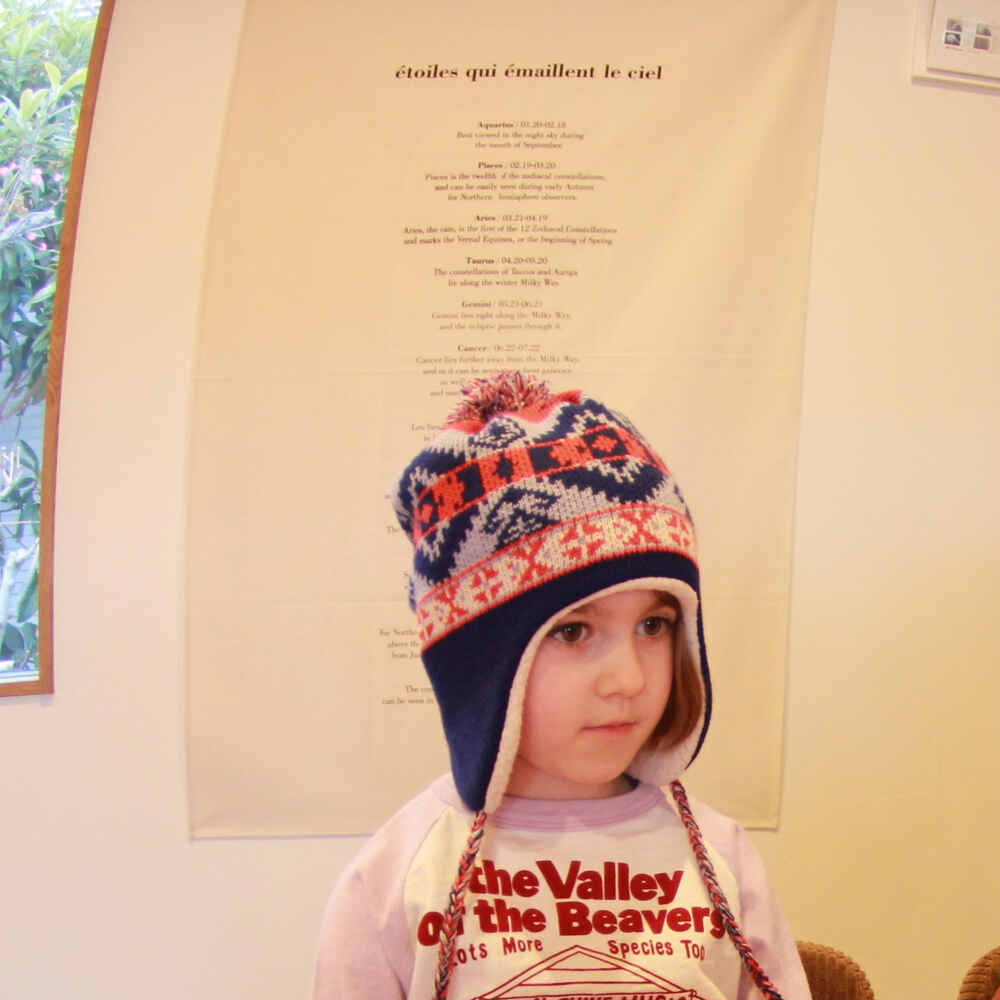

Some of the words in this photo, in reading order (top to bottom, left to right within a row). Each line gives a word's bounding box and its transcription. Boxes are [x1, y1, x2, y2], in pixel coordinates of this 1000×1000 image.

[395, 64, 458, 80] étoiles
[466, 63, 498, 82] qui
[504, 63, 596, 80] émaillent
[604, 64, 621, 80] le
[628, 65, 663, 80] ciel
[477, 121, 514, 130] Aquarius
[466, 256, 494, 265] Taurus
[469, 859, 540, 898] the
[536, 860, 684, 905] Valley
[473, 898, 547, 934] the
[556, 901, 726, 940] Beavers
[456, 942, 488, 967] ots
[501, 937, 544, 956] More
[607, 938, 674, 959] Species
